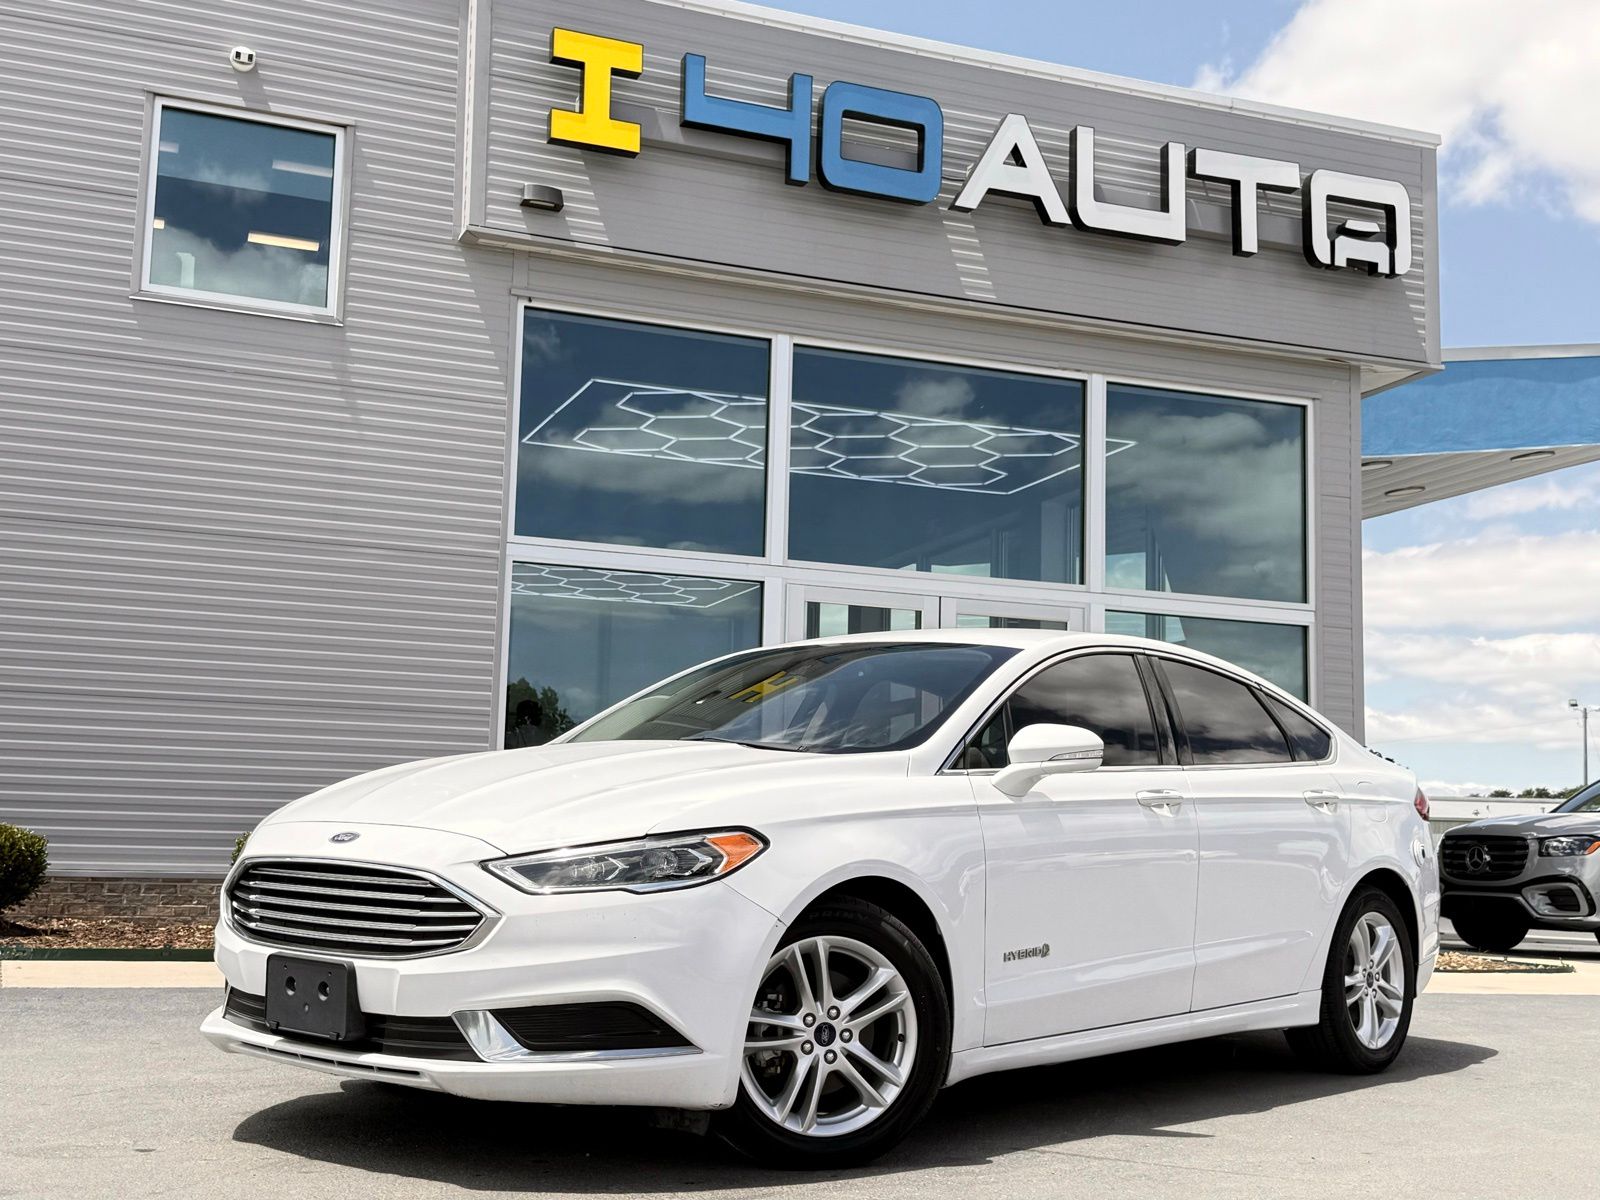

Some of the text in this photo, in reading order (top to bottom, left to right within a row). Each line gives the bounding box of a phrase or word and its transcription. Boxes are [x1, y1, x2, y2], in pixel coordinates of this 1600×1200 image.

[547, 27, 1412, 279] I 40 AUTO
[1003, 946, 1042, 962] HYBRID
